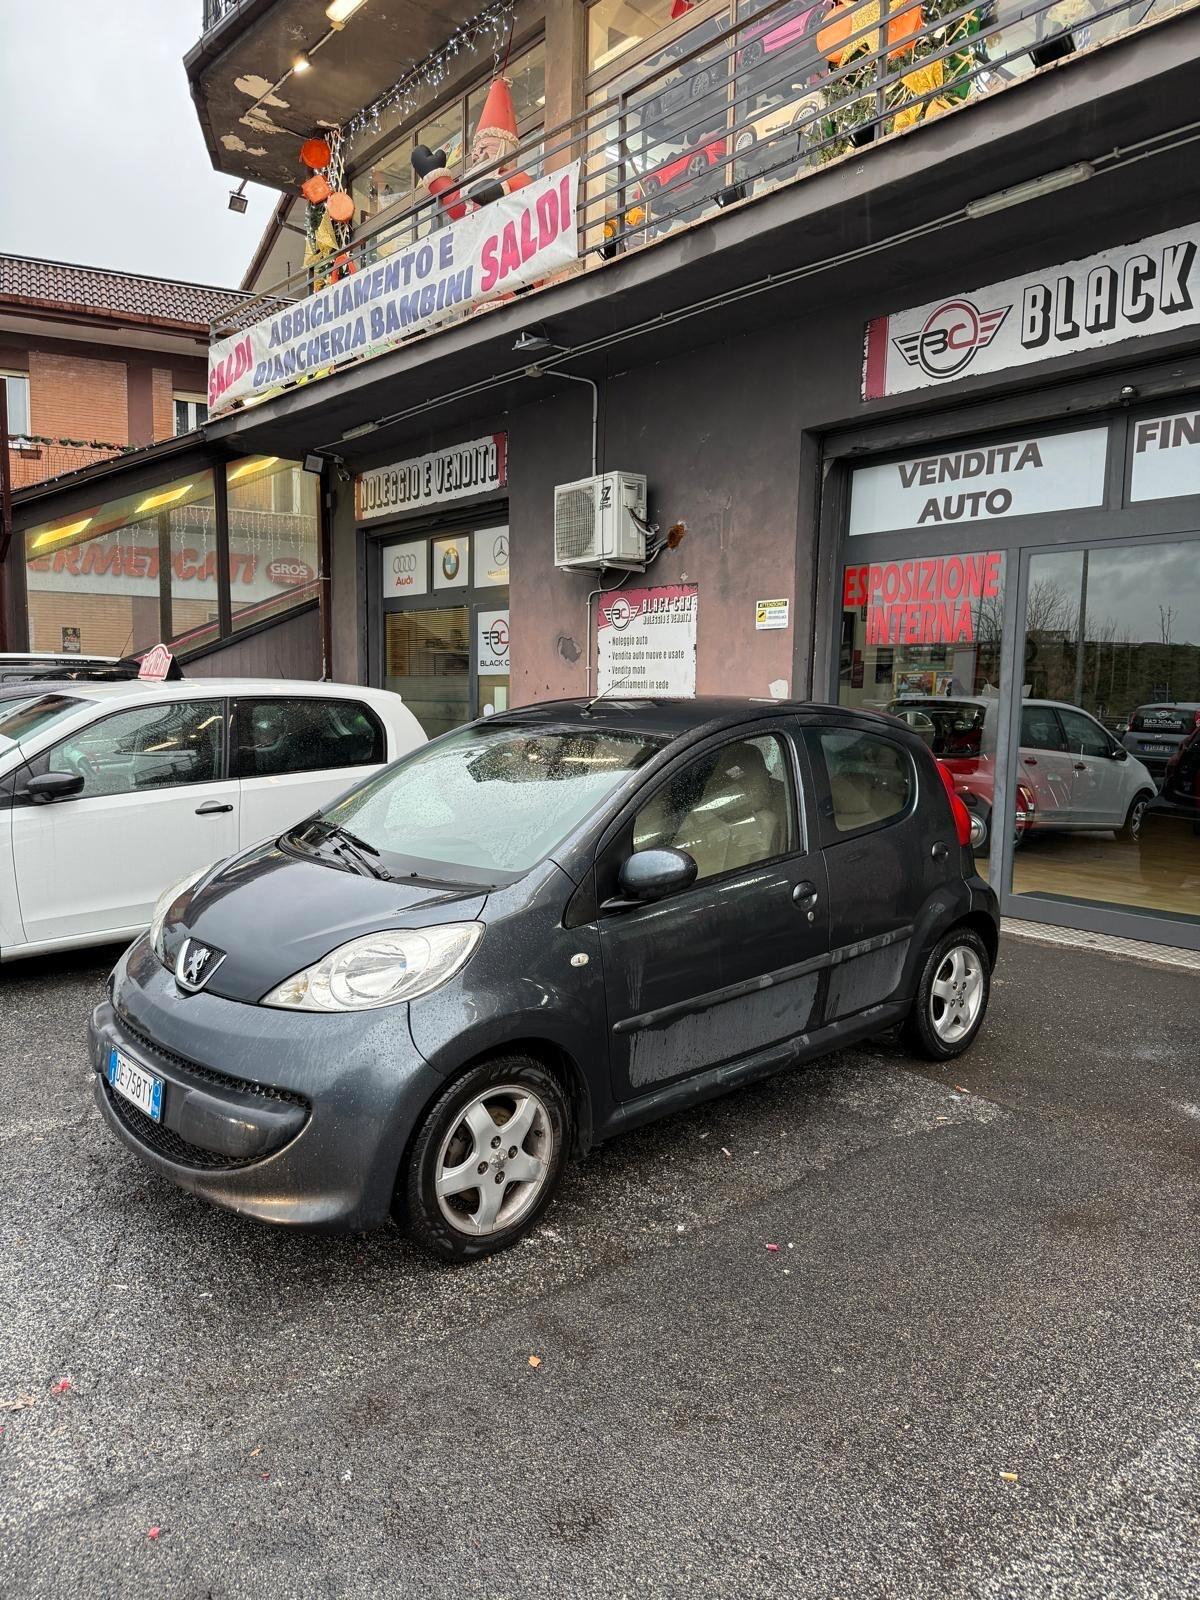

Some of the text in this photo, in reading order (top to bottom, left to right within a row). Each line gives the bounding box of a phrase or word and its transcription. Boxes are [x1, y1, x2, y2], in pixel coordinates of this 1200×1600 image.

[481, 175, 572, 292] SALDI
[268, 245, 434, 349] ABBIGLIAMENTO
[1021, 241, 1198, 350] BLACK
[252, 265, 474, 388] BIANCHERIA BAMBINI
[208, 334, 254, 408] SALDI
[1136, 413, 1200, 453] FIN
[360, 443, 499, 511] NOLEGGIO E VENDITA
[898, 442, 1043, 488] VENDITA
[917, 488, 1012, 524] AUTO
[271, 563, 308, 576] GROS
[395, 575, 413, 586] Audi
[843, 551, 1001, 606] ESPOSIZIONE
[642, 595, 692, 614] BLACK CAR
[866, 601, 974, 645] INTERNA
[612, 635, 648, 647] Noleggio auto
[612, 651, 632, 660] Vendita
[633, 650, 644, 660] auto
[645, 651, 662, 660] nuove
[668, 650, 685, 659] usate
[612, 665, 646, 675] Vendita moto
[612, 679, 669, 690] Finanziamenti in sede
